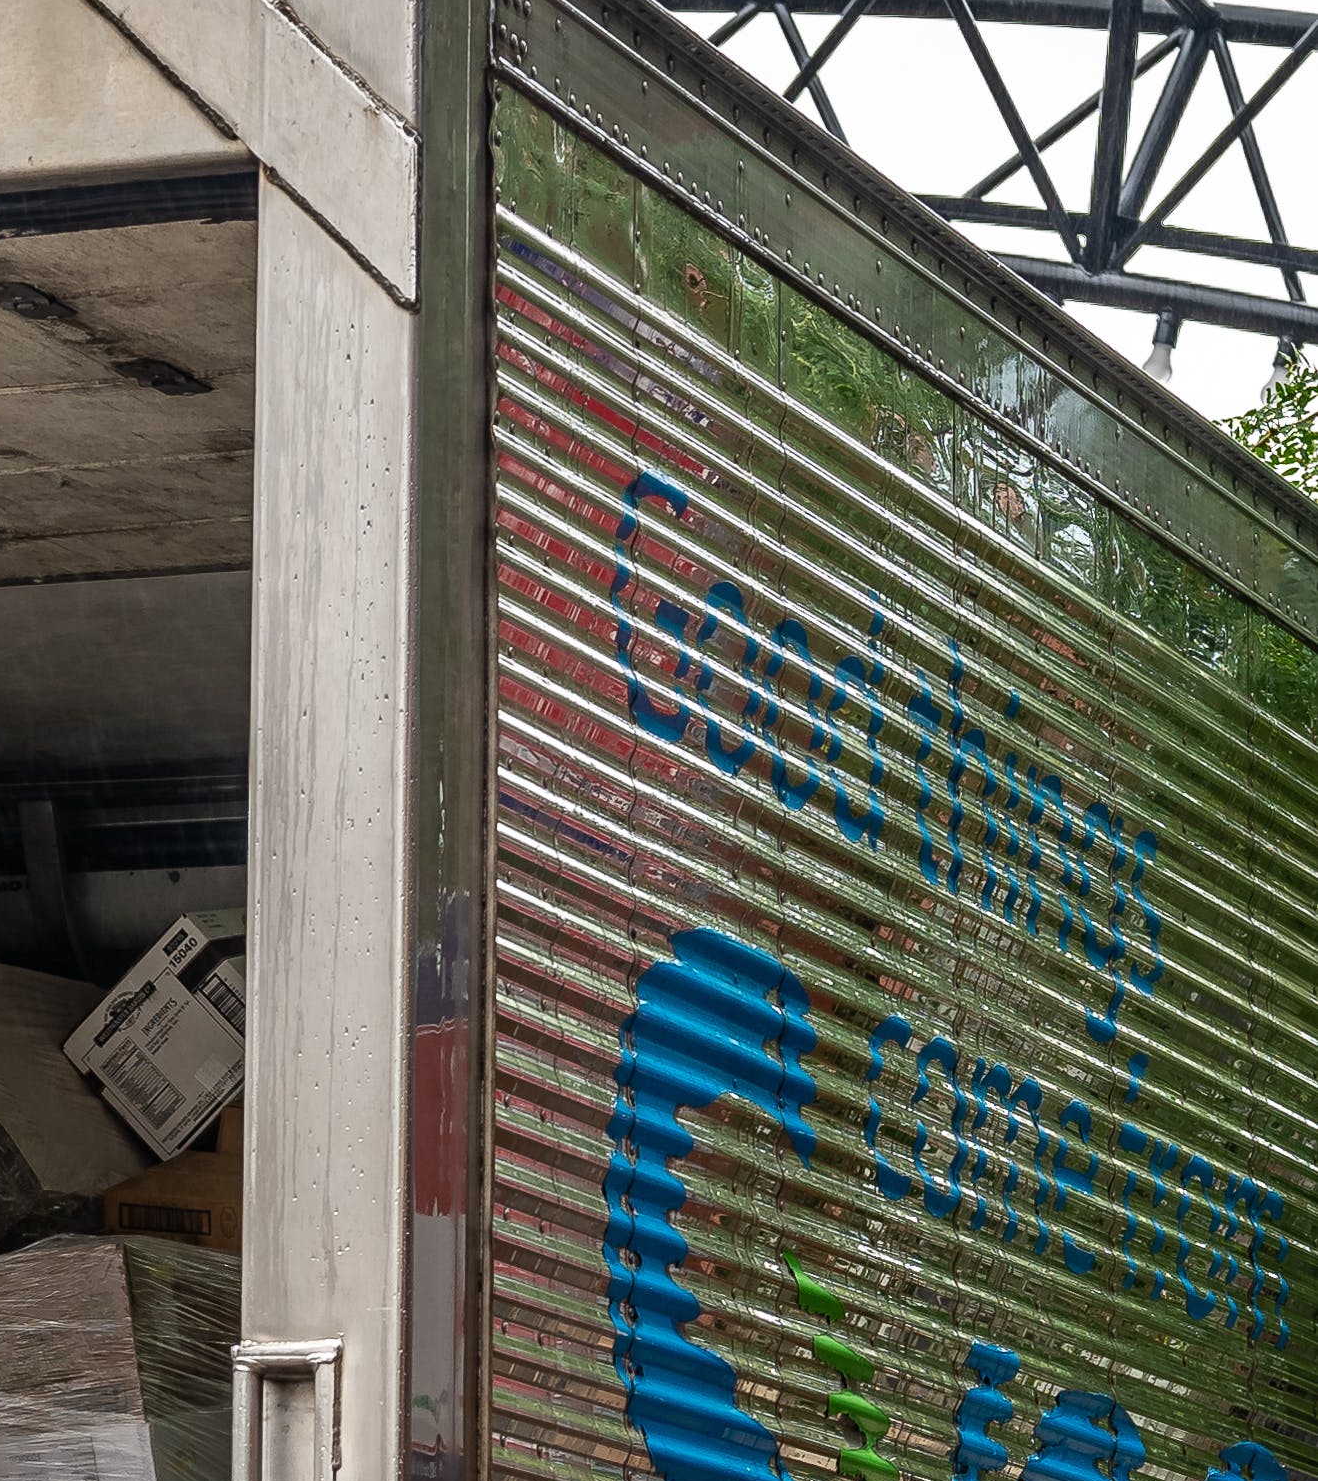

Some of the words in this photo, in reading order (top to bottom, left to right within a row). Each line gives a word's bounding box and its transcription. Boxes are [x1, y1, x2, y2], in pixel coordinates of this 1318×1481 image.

[615, 469, 886, 849] Good
[908, 637, 1164, 1043] things
[168, 937, 198, 969] 15040
[868, 1016, 1102, 1274] come
[1120, 1052, 1290, 1350] from
